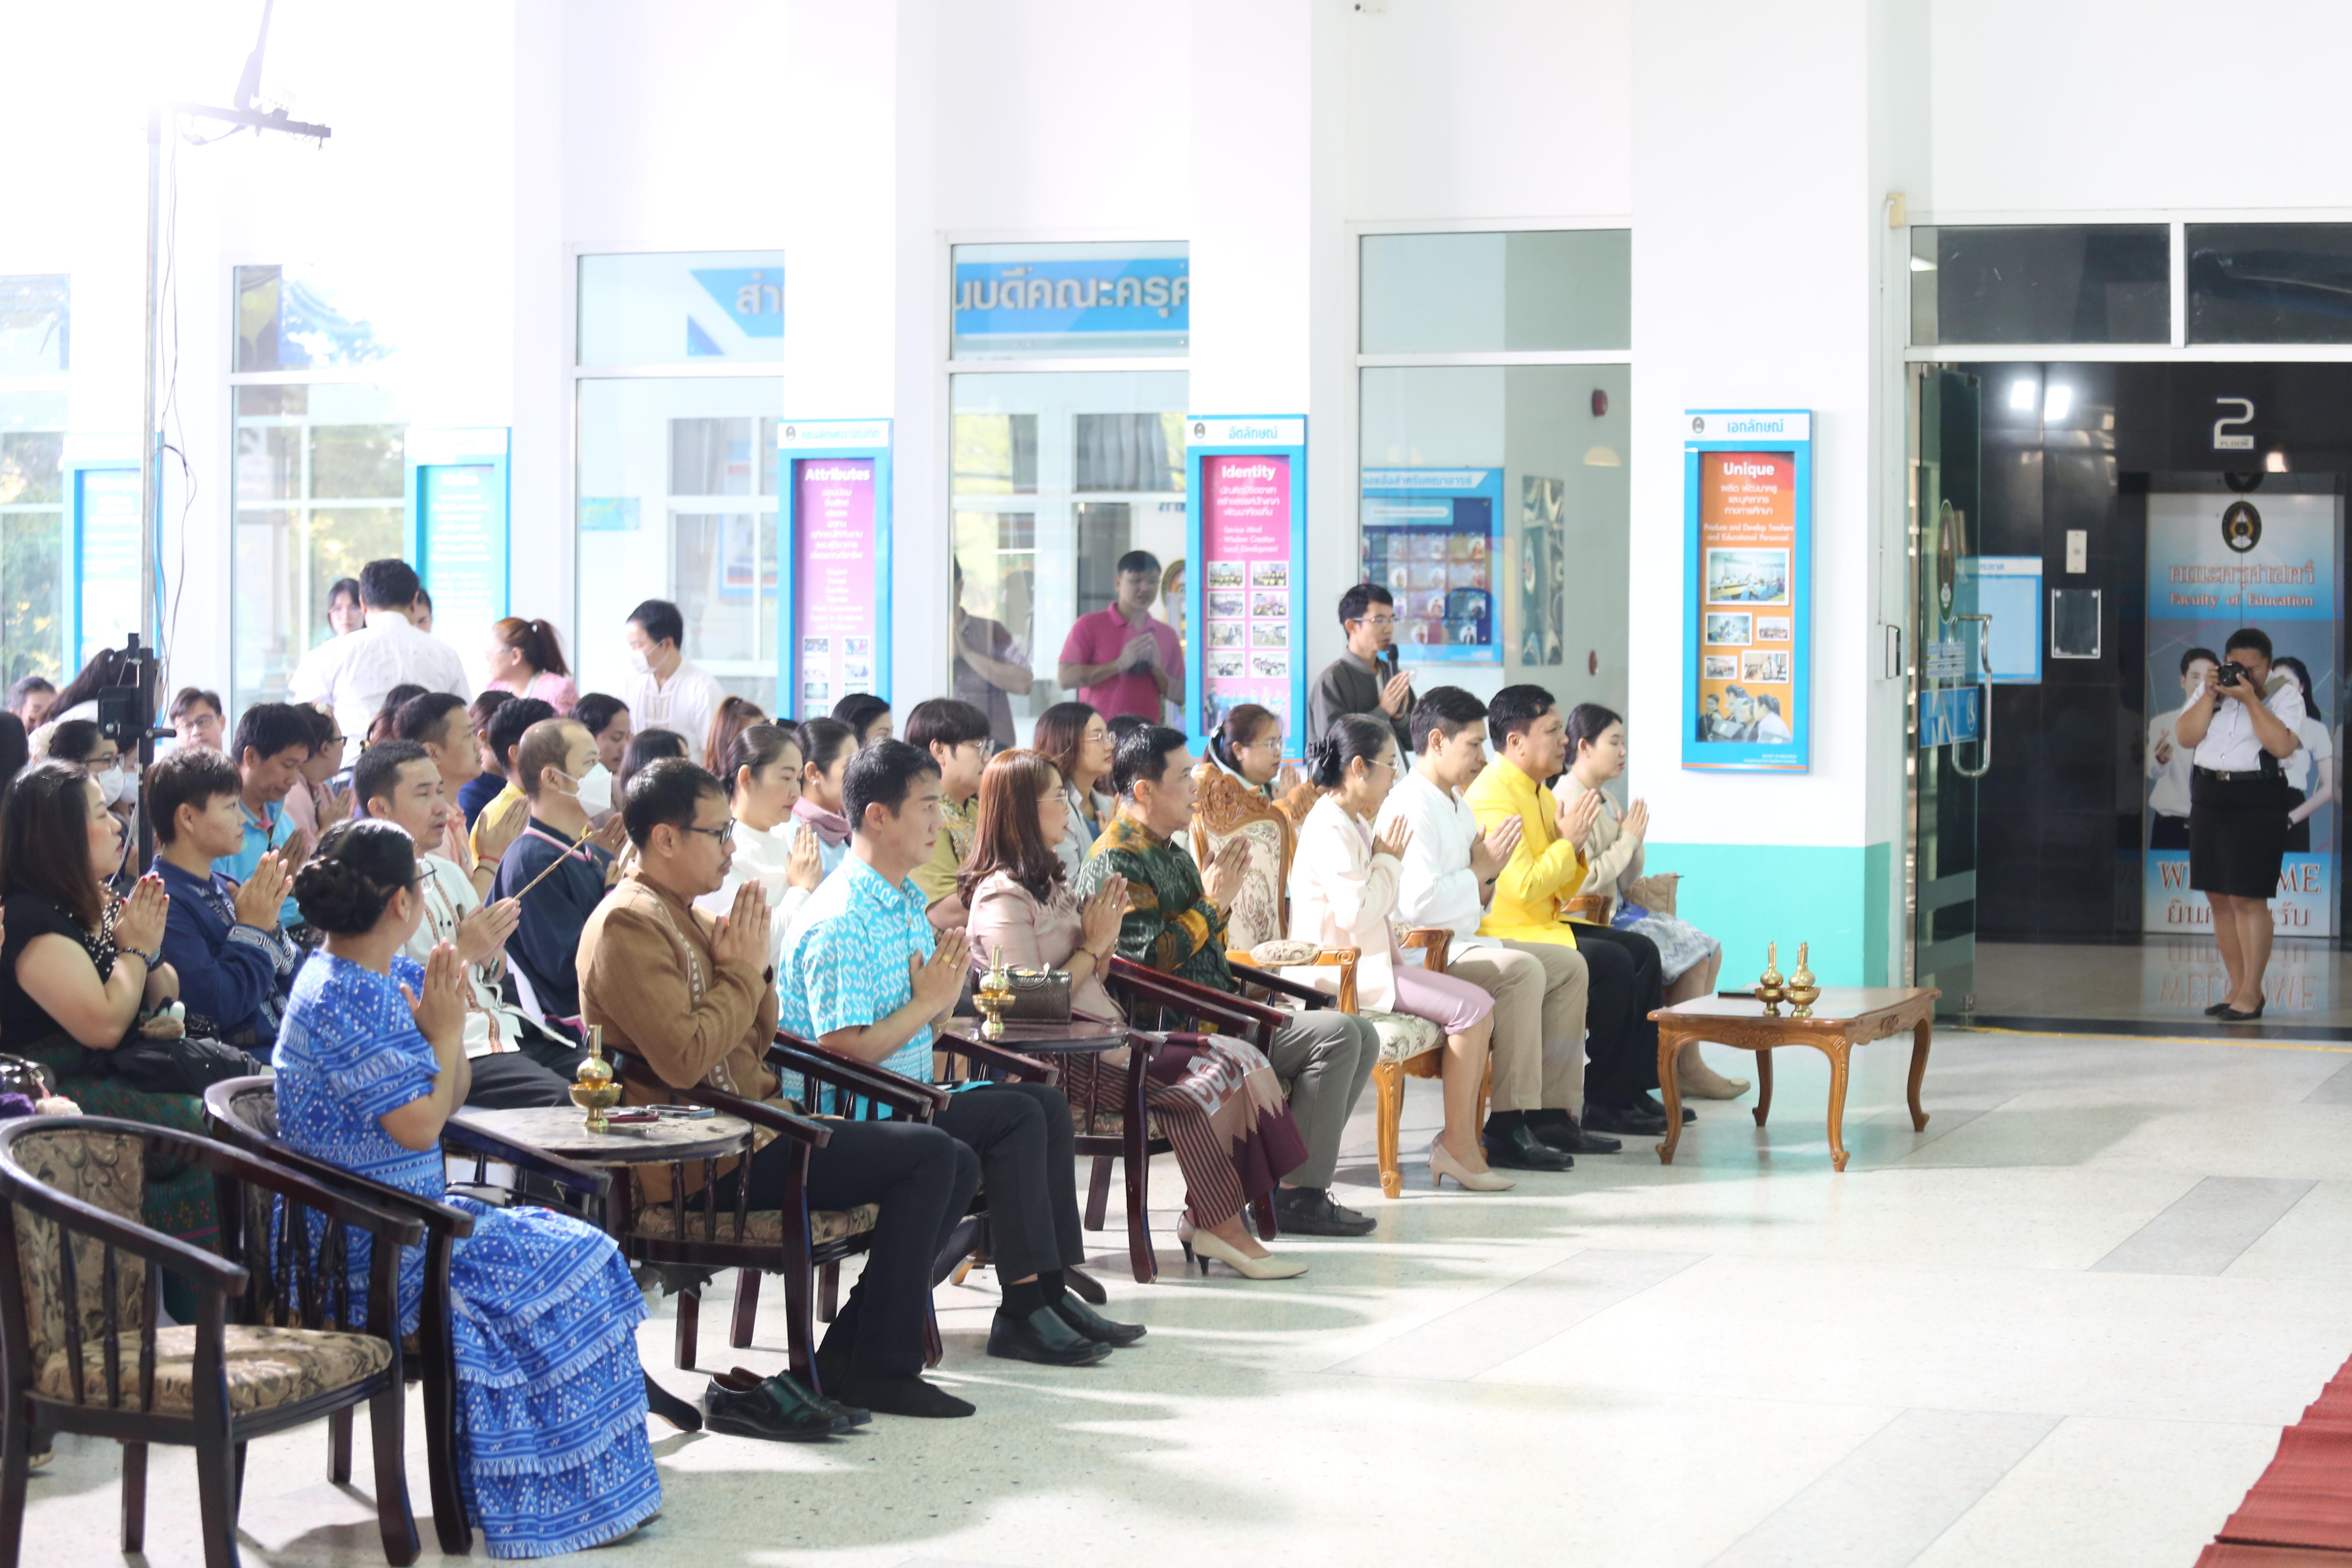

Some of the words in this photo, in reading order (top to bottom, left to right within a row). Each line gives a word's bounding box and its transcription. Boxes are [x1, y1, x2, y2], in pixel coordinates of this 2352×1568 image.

[1727, 419, 1784, 432] เอกลักษณ์
[2214, 398, 2254, 449] 2
[805, 468, 871, 481] Attributes
[1221, 465, 1276, 481] Identity
[1723, 461, 1775, 479] Unique
[2169, 592, 2220, 610] Faculty
[2227, 594, 2241, 606] of
[2247, 592, 2314, 606] Education
